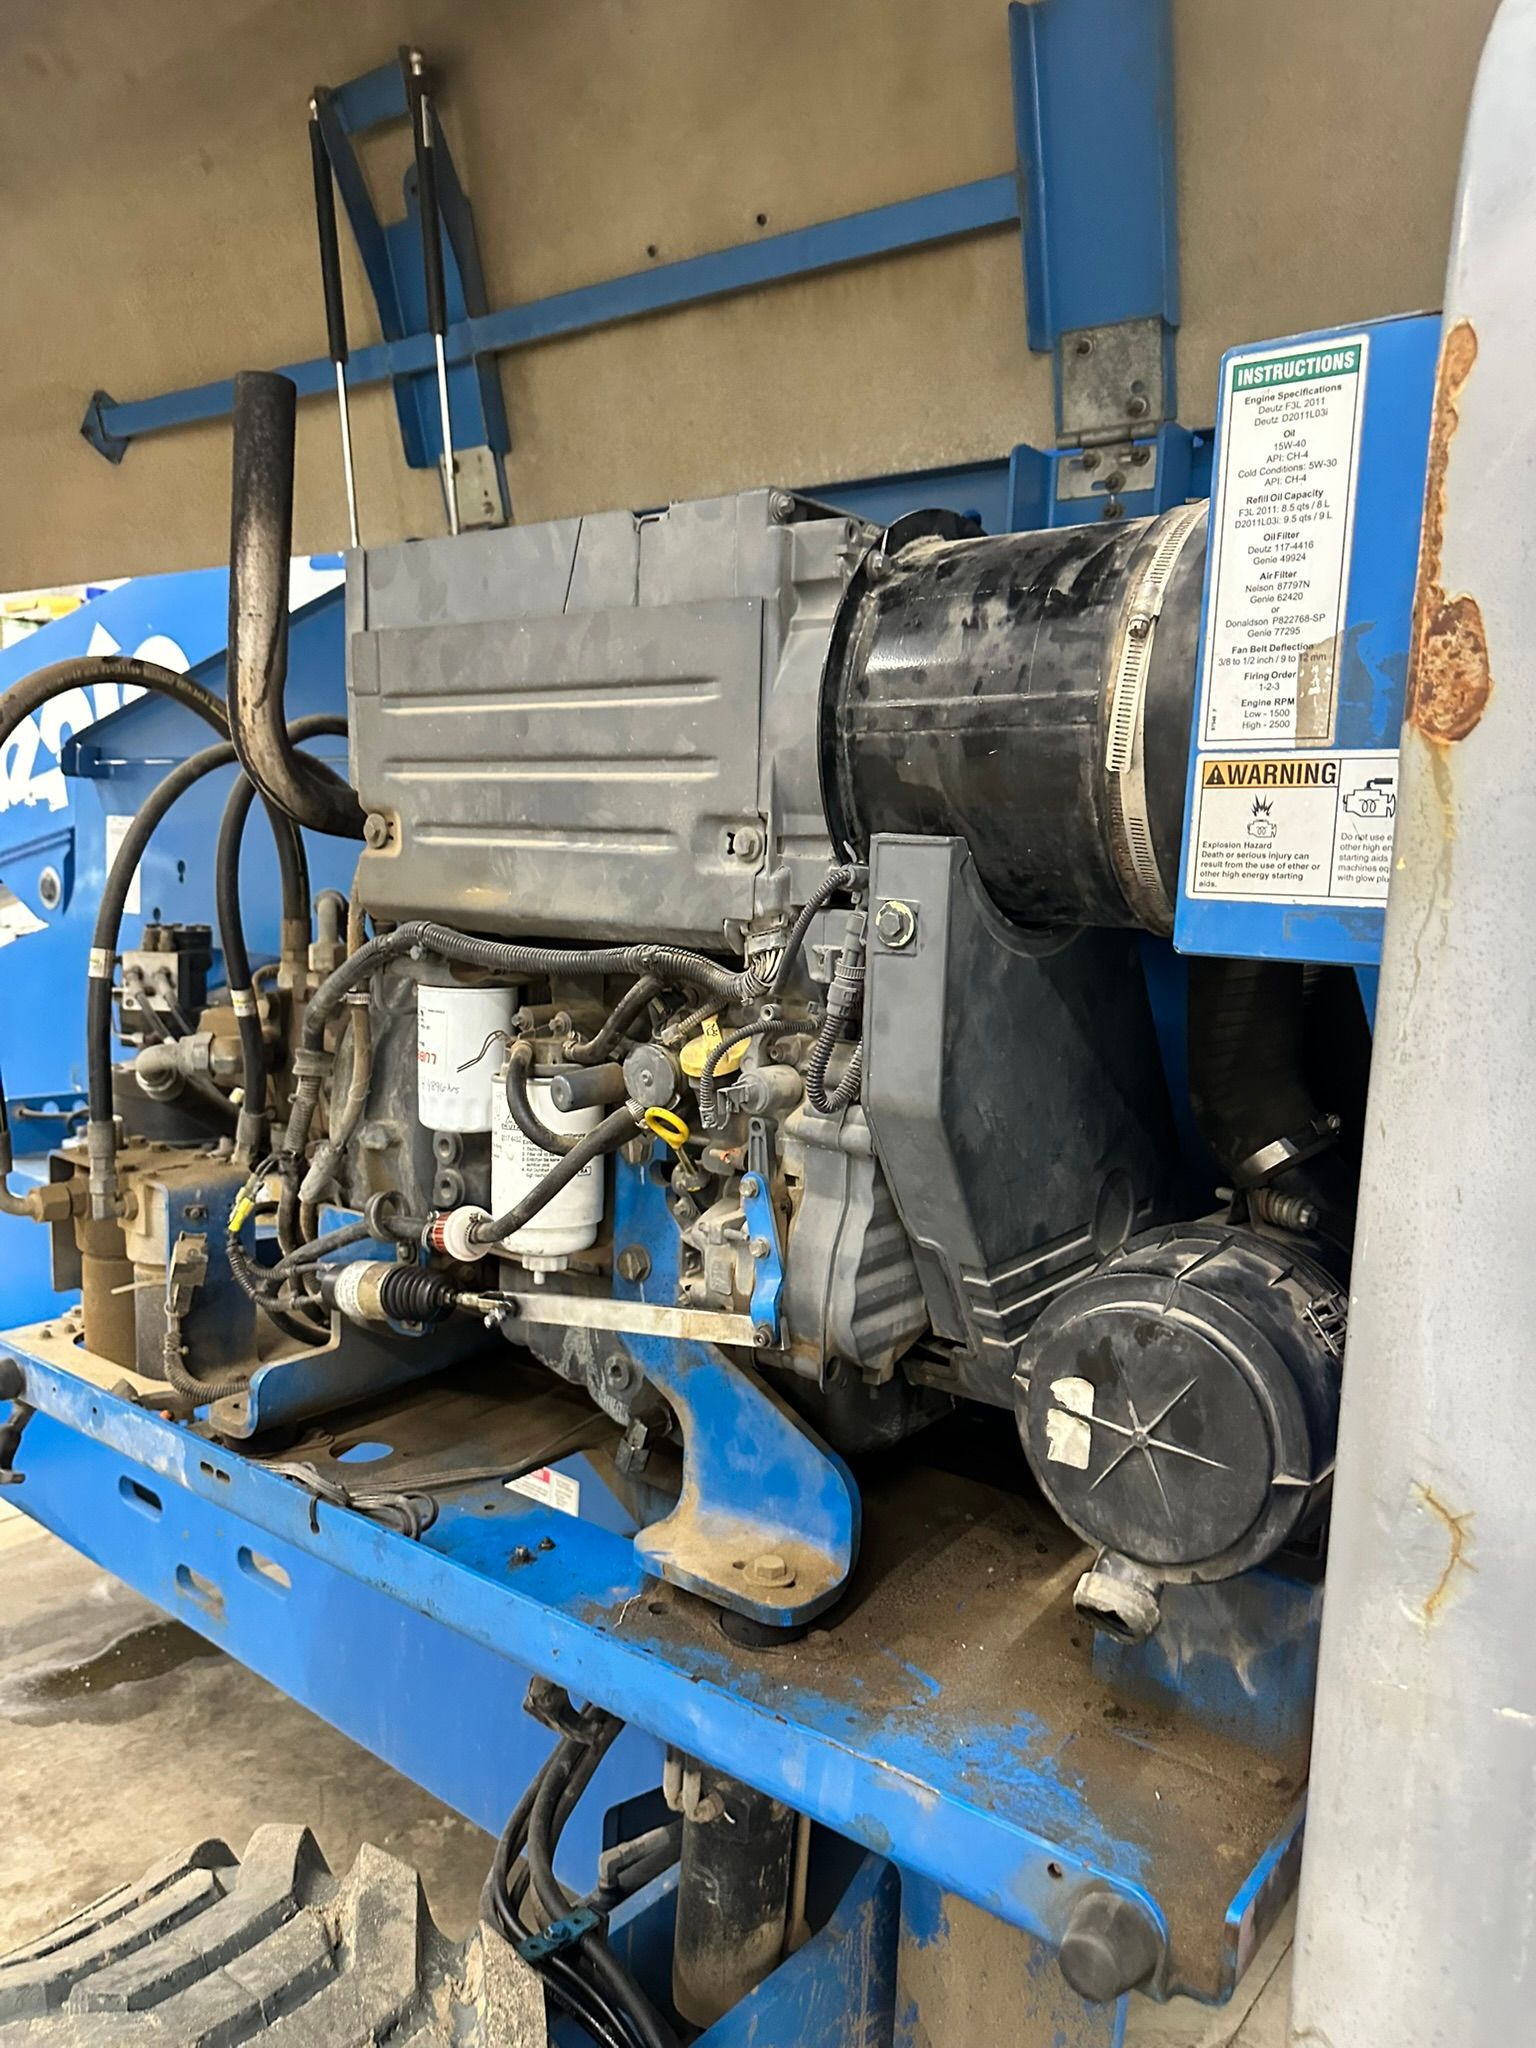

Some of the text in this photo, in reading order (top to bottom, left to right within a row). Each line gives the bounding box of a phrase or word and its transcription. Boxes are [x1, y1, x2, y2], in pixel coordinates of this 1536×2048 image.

[1238, 351, 1355, 386] INSTRUCTIONS
[1245, 384, 1342, 405] Engine Specifications
[1258, 397, 1325, 414] Deutz F3L 2011
[1254, 408, 1328, 426] Deutz D2011L03i
[1284, 429, 1295, 438] Oil
[1274, 439, 1306, 451] 15W-40
[1266, 450, 1308, 463] API: CH-4
[1238, 458, 1337, 478] Cold Conditions: 5W-30
[1264, 474, 1306, 486] API: CH-4
[1246, 489, 1323, 504] Refill Oil Capacity
[1239, 508, 1254, 517] F3L
[1282, 503, 1294, 512] 8.5
[1297, 503, 1309, 512] qts
[1317, 500, 1322, 508] 8
[1324, 500, 1330, 508] L
[1284, 514, 1296, 523] 9.5
[1299, 514, 1311, 523] qts
[1319, 512, 1324, 520] 9
[1327, 511, 1332, 519] L
[1264, 532, 1299, 541] Oil Filter
[1248, 540, 1313, 554] Deutz 117-4416
[1253, 553, 1306, 565] Genie 49924
[1260, 571, 1297, 580] Air Filter
[1245, 584, 1273, 592] Nelson
[1250, 592, 1303, 603] Genie 62420
[1226, 613, 1325, 628] Donaldson P822768-SP
[1247, 626, 1300, 637] Genie 77295
[1232, 643, 1314, 654] Fan Belt Deflection
[1218, 658, 1231, 666] 3/8
[1244, 656, 1255, 664] 1/2
[1257, 656, 1273, 664] inch
[1281, 655, 1286, 663] 9
[1300, 653, 1308, 661] 12
[1310, 653, 1326, 661] mm
[1244, 671, 1296, 681] Firing Order
[1260, 682, 1279, 691] 1-2-3
[1241, 698, 1294, 708] Engine RPM
[1244, 710, 1261, 718] Low
[1270, 709, 1290, 717] 1500
[1242, 721, 1261, 730] High
[1269, 720, 1290, 728] 2500
[1228, 763, 1336, 785] WARNING
[1341, 832, 1352, 840] Do
[1202, 841, 1241, 849] Explosion
[1363, 844, 1380, 853] high
[1237, 851, 1266, 859] serious
[1268, 852, 1292, 861] injury
[1339, 854, 1388, 863] starting aids
[1338, 864, 1376, 872] machines
[1222, 870, 1239, 879] high
[1242, 872, 1269, 880] energy
[1272, 873, 1303, 881] starting
[1356, 874, 1375, 883] glow
